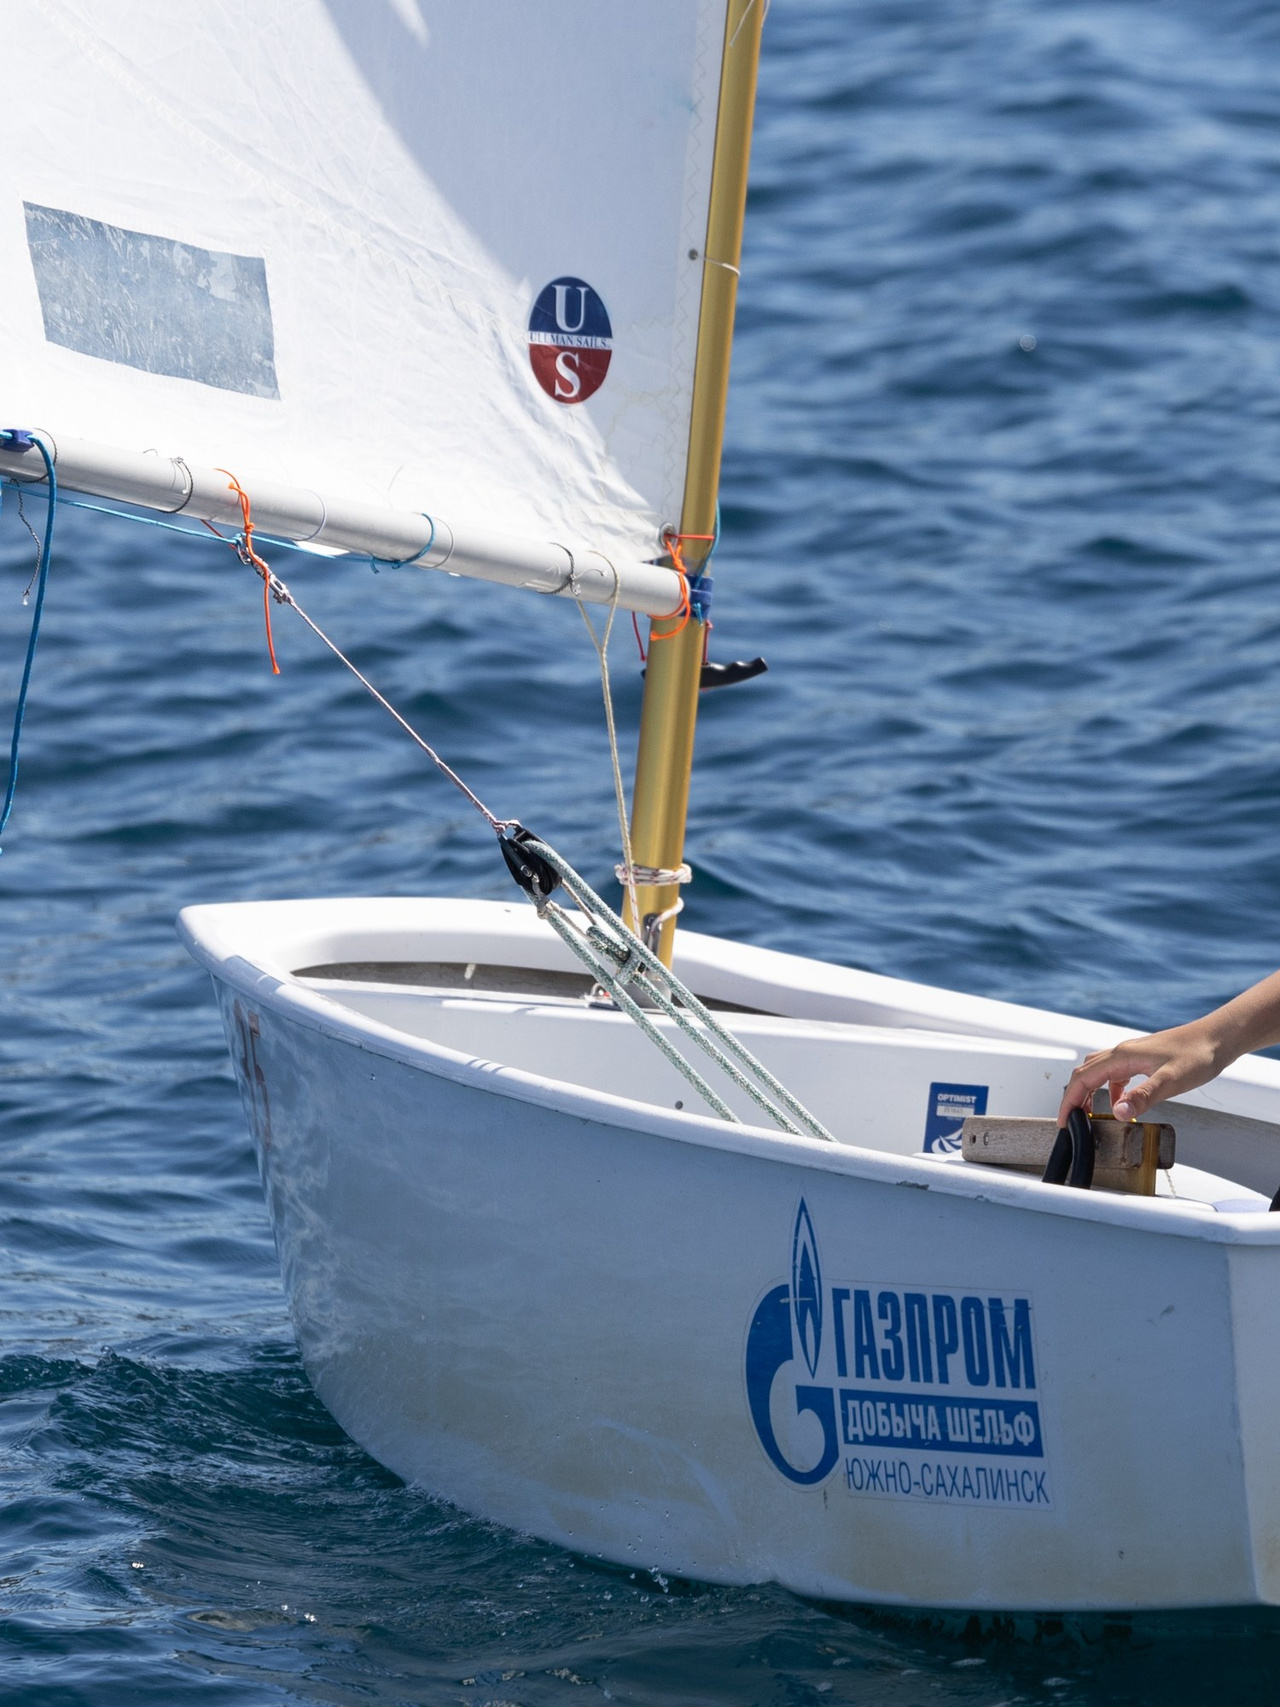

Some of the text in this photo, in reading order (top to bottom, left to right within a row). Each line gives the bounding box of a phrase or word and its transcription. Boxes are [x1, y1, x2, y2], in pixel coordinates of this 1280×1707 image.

[552, 285, 590, 333] U
[577, 336, 607, 349] SAILS
[555, 351, 581, 398] S
[937, 1092, 977, 1104] OPTIMIST
[832, 1287, 1037, 1390] ГАЗПРОМ
[847, 1399, 1036, 1447] ДОБЫЧА ШЕЛЬФ
[845, 1457, 1050, 1504] ЮЖНО-САХАЛИНСК
